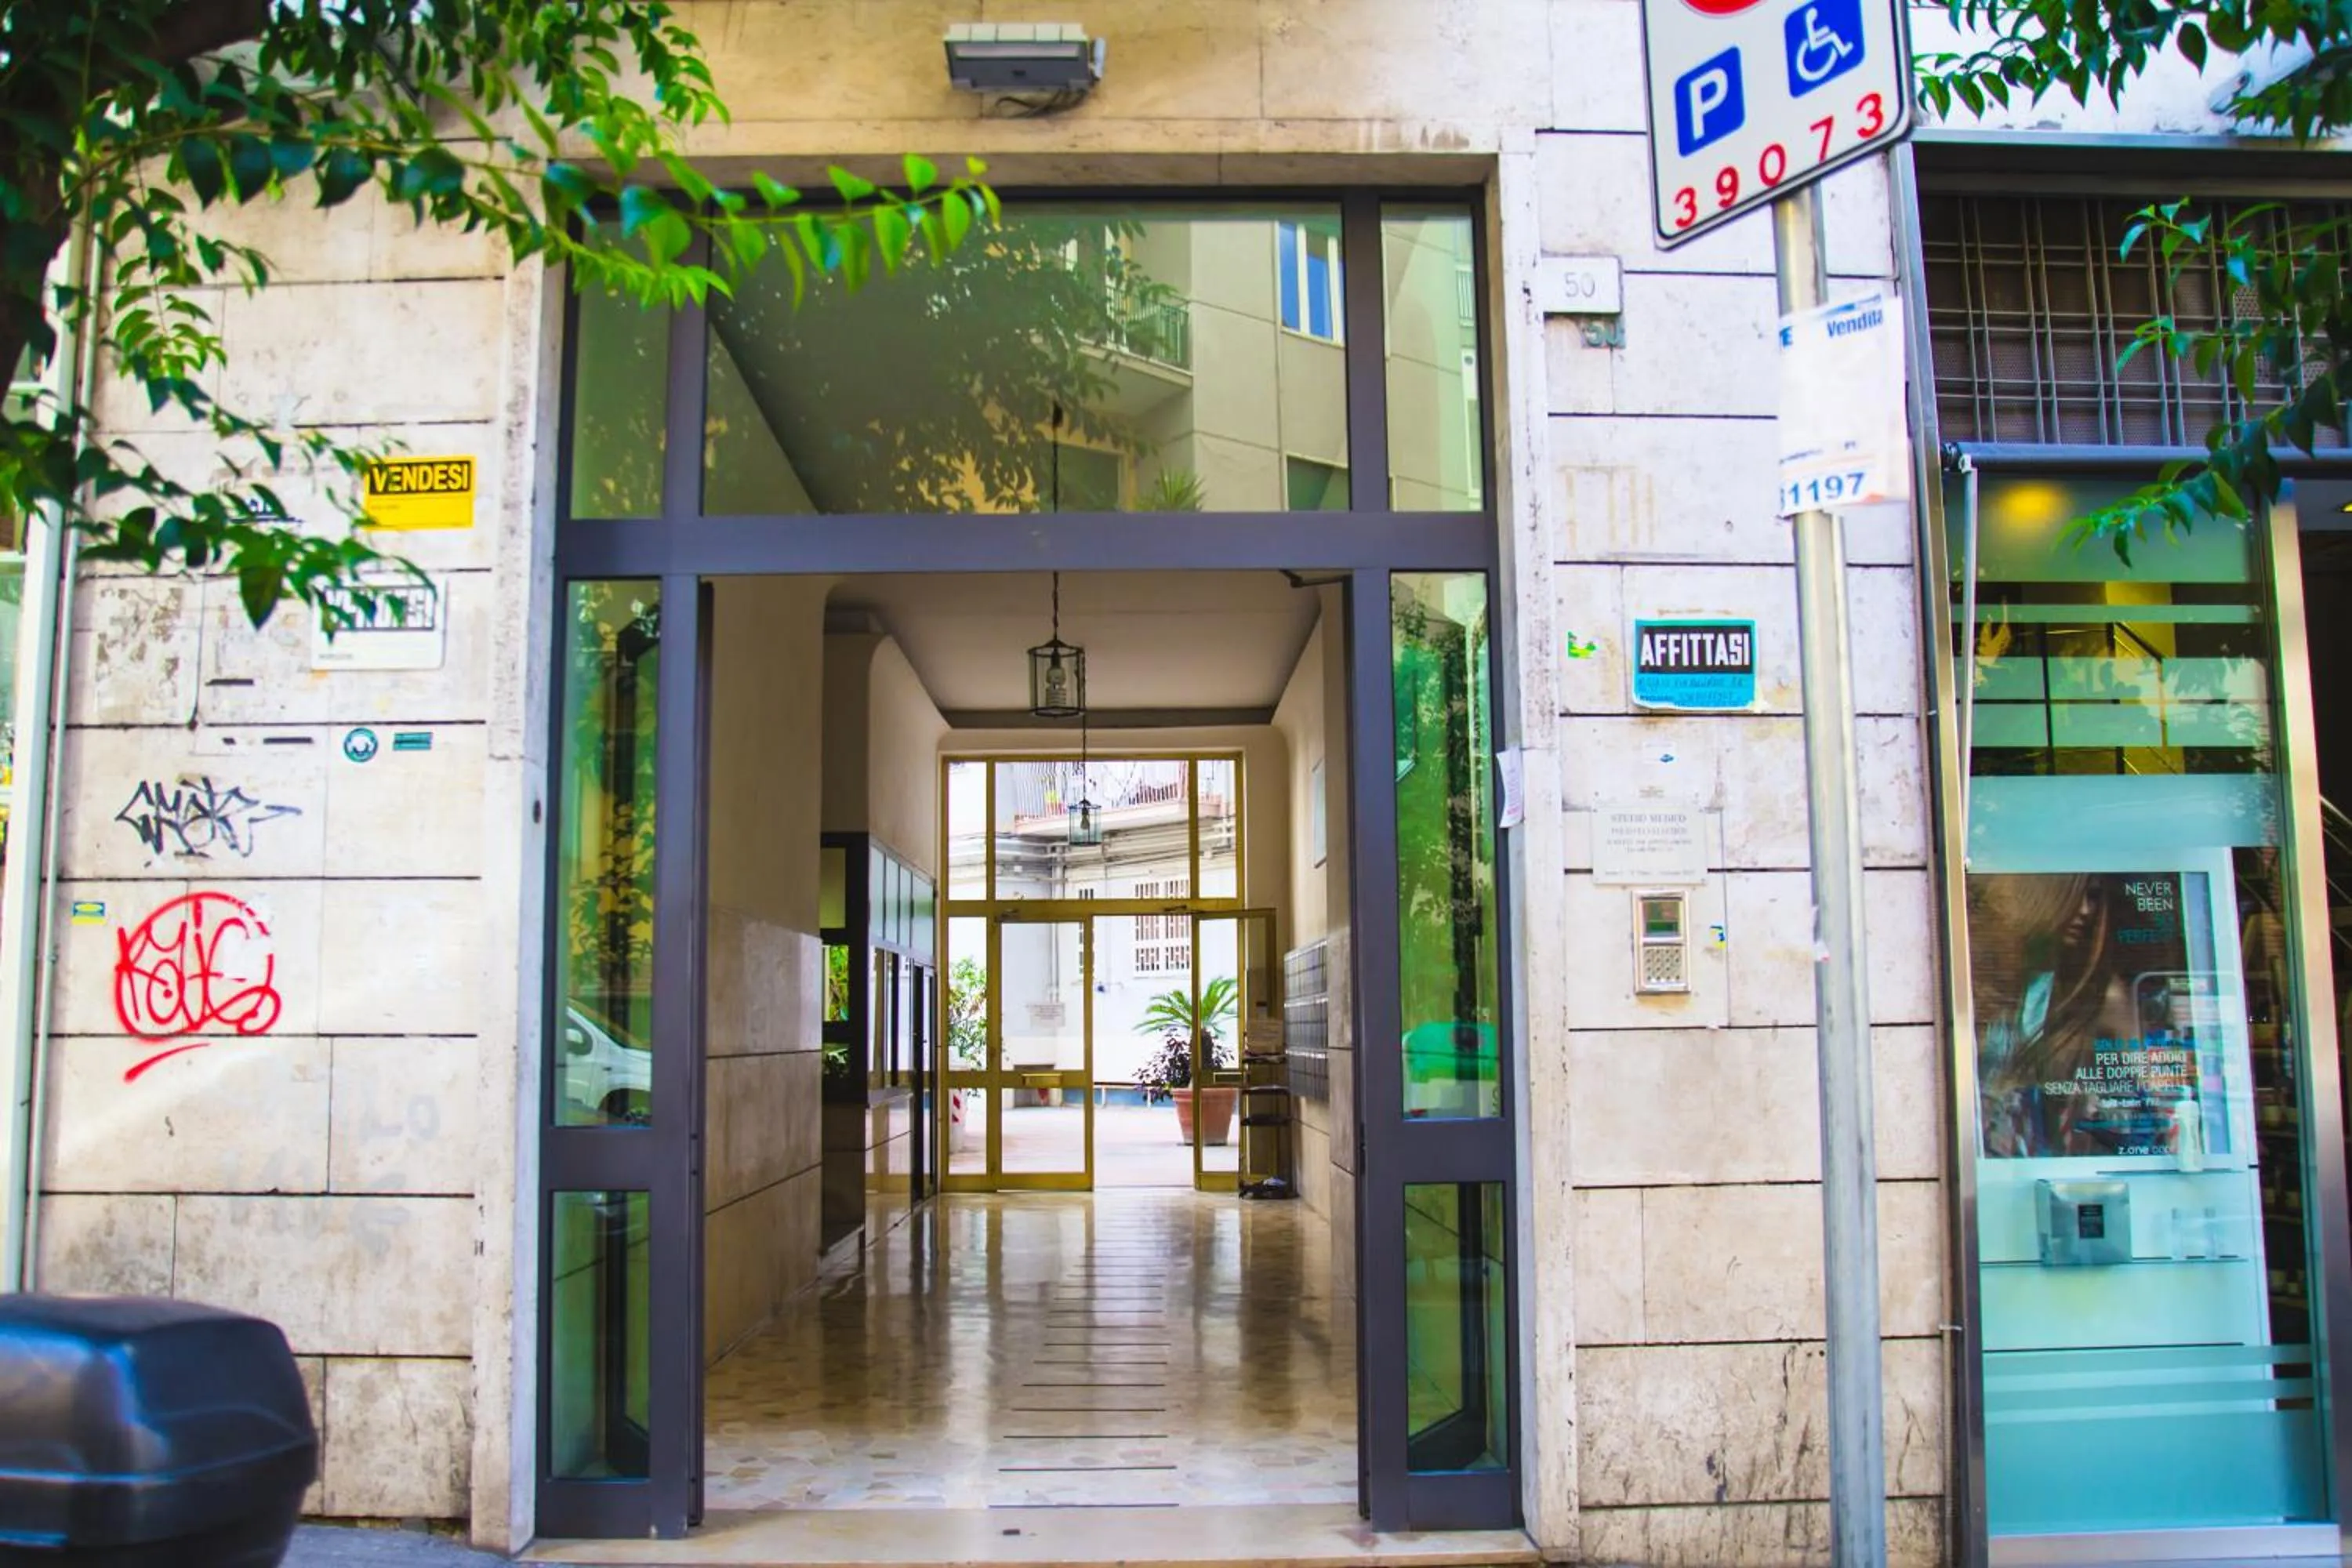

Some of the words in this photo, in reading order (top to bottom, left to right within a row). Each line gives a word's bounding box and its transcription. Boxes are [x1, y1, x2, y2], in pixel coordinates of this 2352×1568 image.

[1564, 271, 1595, 298] 50
[372, 463, 468, 492] VENDESI
[1640, 633, 1750, 666] AFFITTASI
[2125, 880, 2173, 895] NEVER
[2136, 898, 2173, 912] BEEN
[2096, 1052, 2118, 1065] PER
[2076, 1066, 2103, 1080] ALLE
[2151, 1064, 2187, 1077] PUNTE
[2045, 1080, 2082, 1095] SENZA
[2082, 1080, 2133, 1094] TAGLIARE
